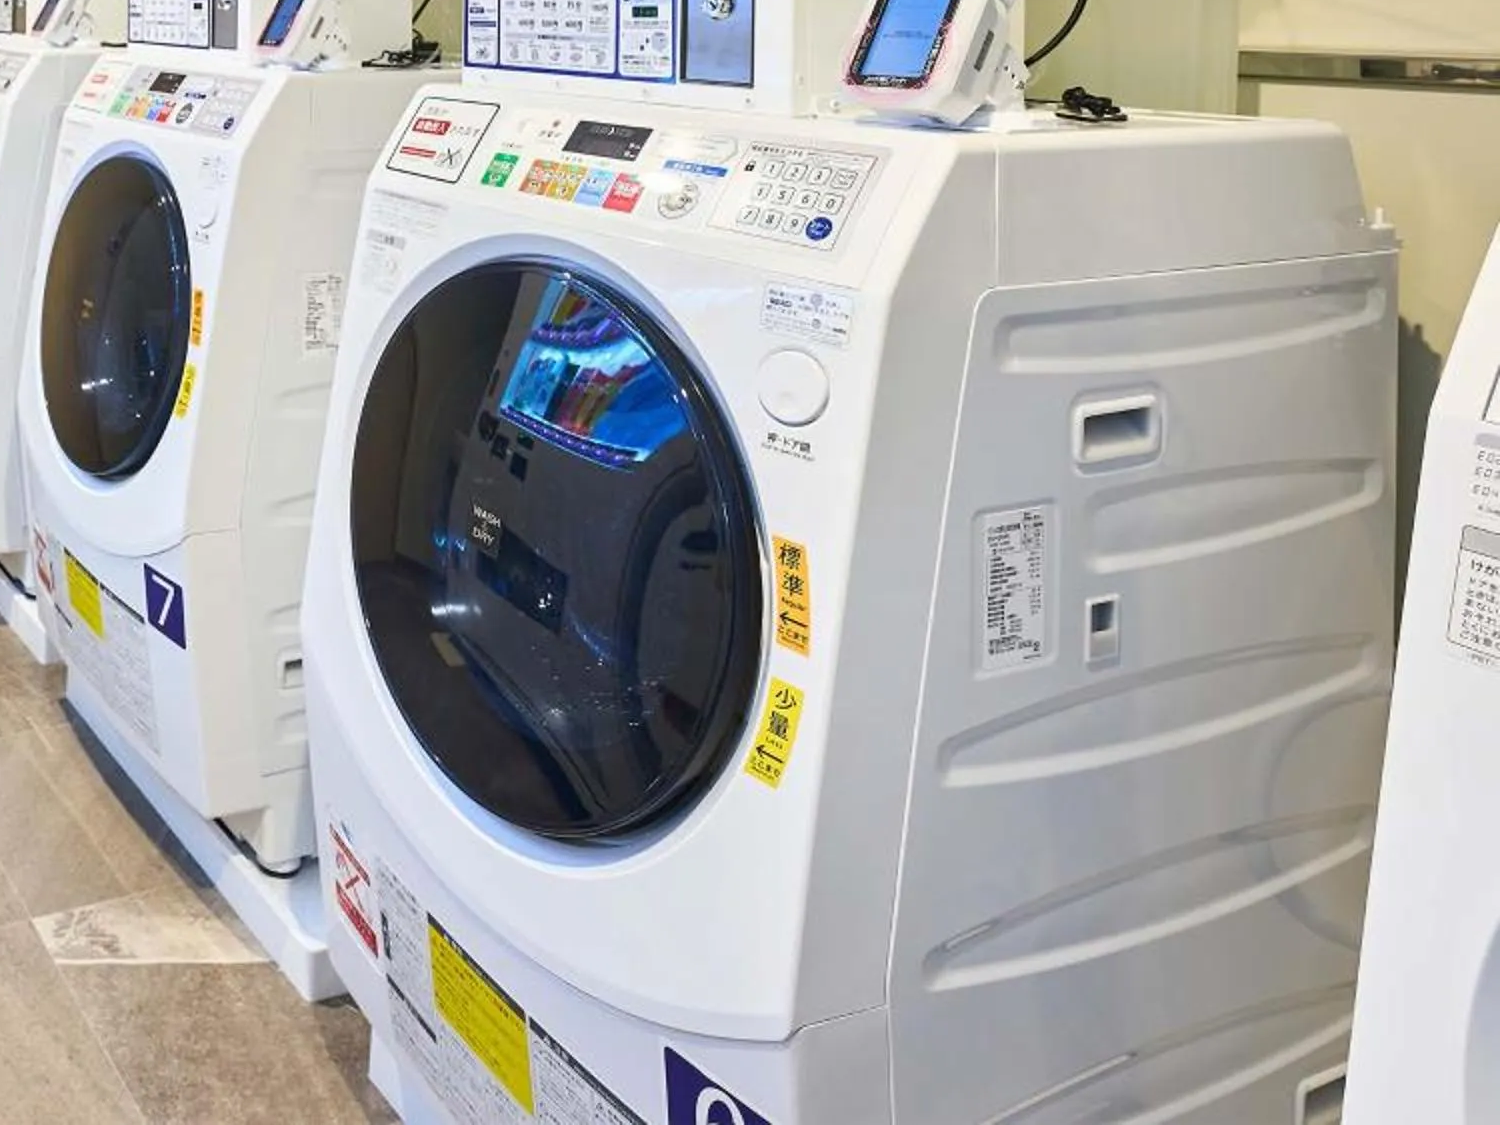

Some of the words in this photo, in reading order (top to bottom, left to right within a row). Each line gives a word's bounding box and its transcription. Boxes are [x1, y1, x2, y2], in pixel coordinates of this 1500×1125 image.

[472, 503, 501, 528] WASH
[472, 526, 495, 547] DRY
[778, 542, 805, 596] 標準
[151, 574, 175, 626] 7
[768, 688, 797, 742] 少量
